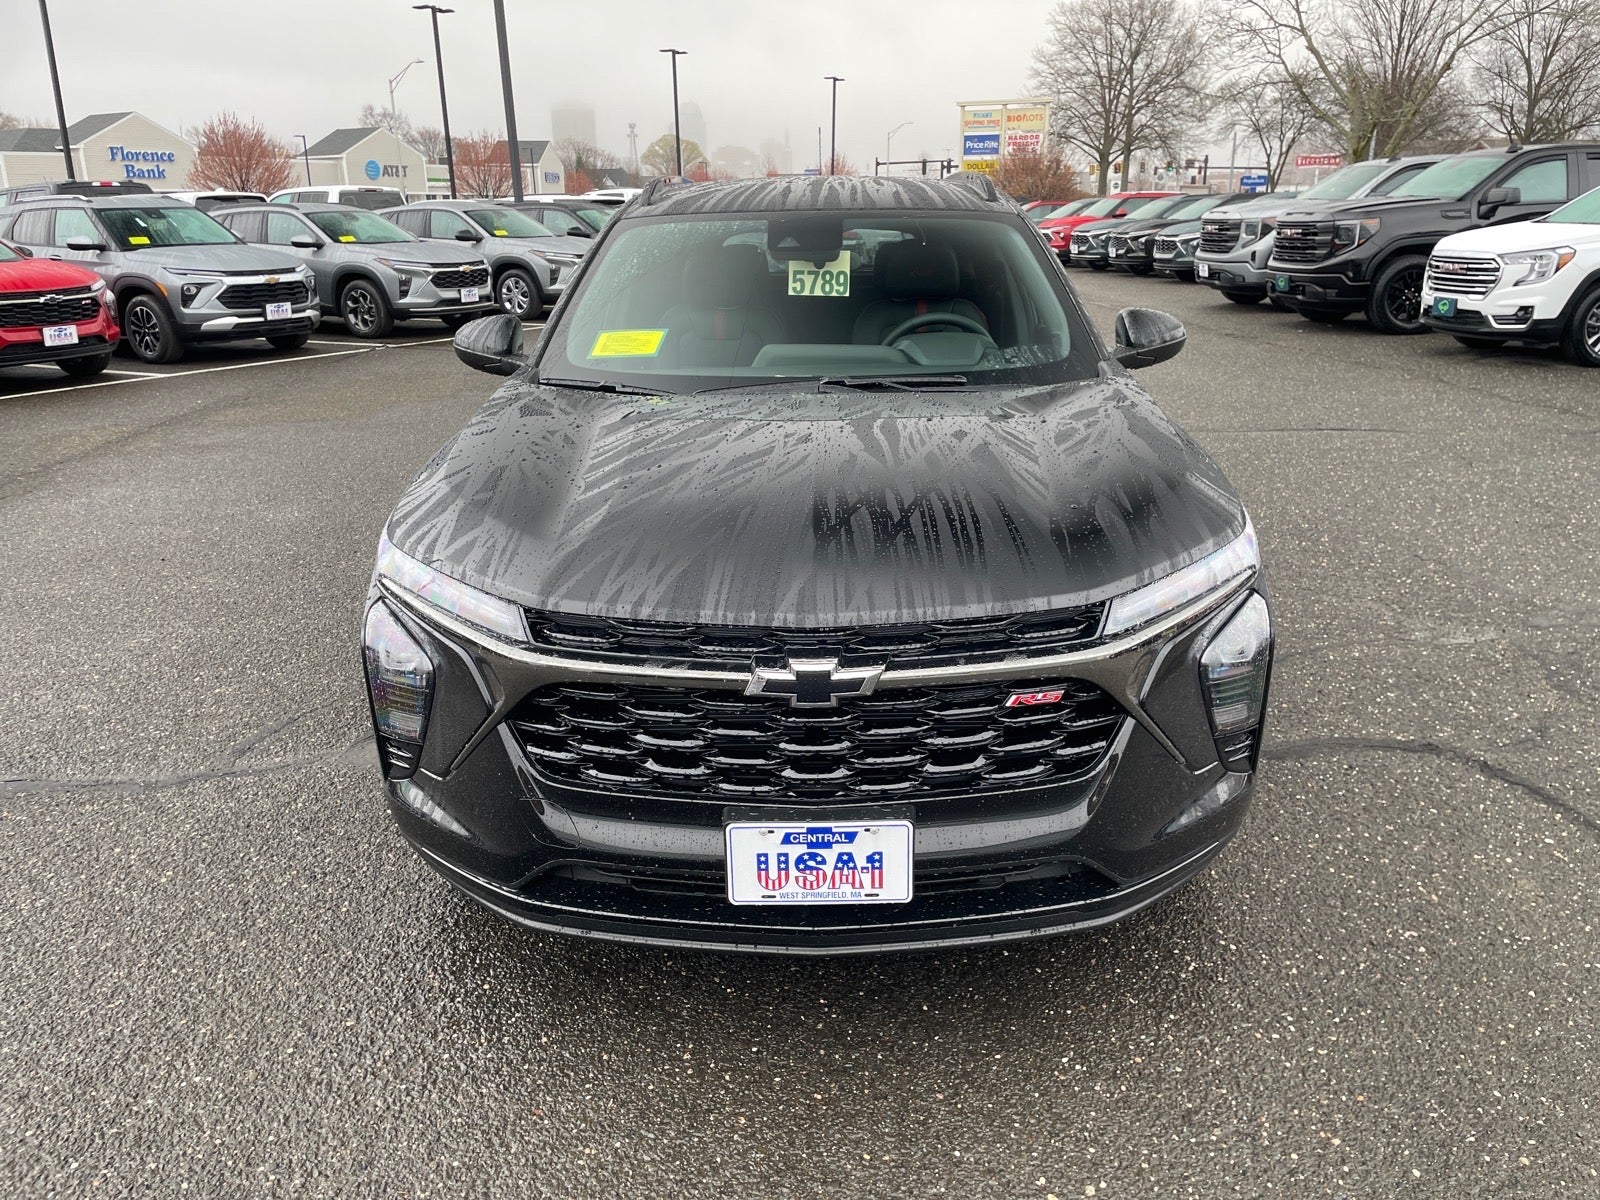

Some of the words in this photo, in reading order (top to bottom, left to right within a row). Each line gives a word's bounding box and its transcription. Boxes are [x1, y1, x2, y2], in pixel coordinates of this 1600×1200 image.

[109, 146, 175, 162] Florence
[124, 164, 166, 179] Bank
[382, 164, 408, 178] AT&T
[791, 270, 849, 296] 5789
[1005, 690, 1065, 707] RS
[790, 833, 849, 843] CENTRAL
[756, 851, 883, 891] USA-1
